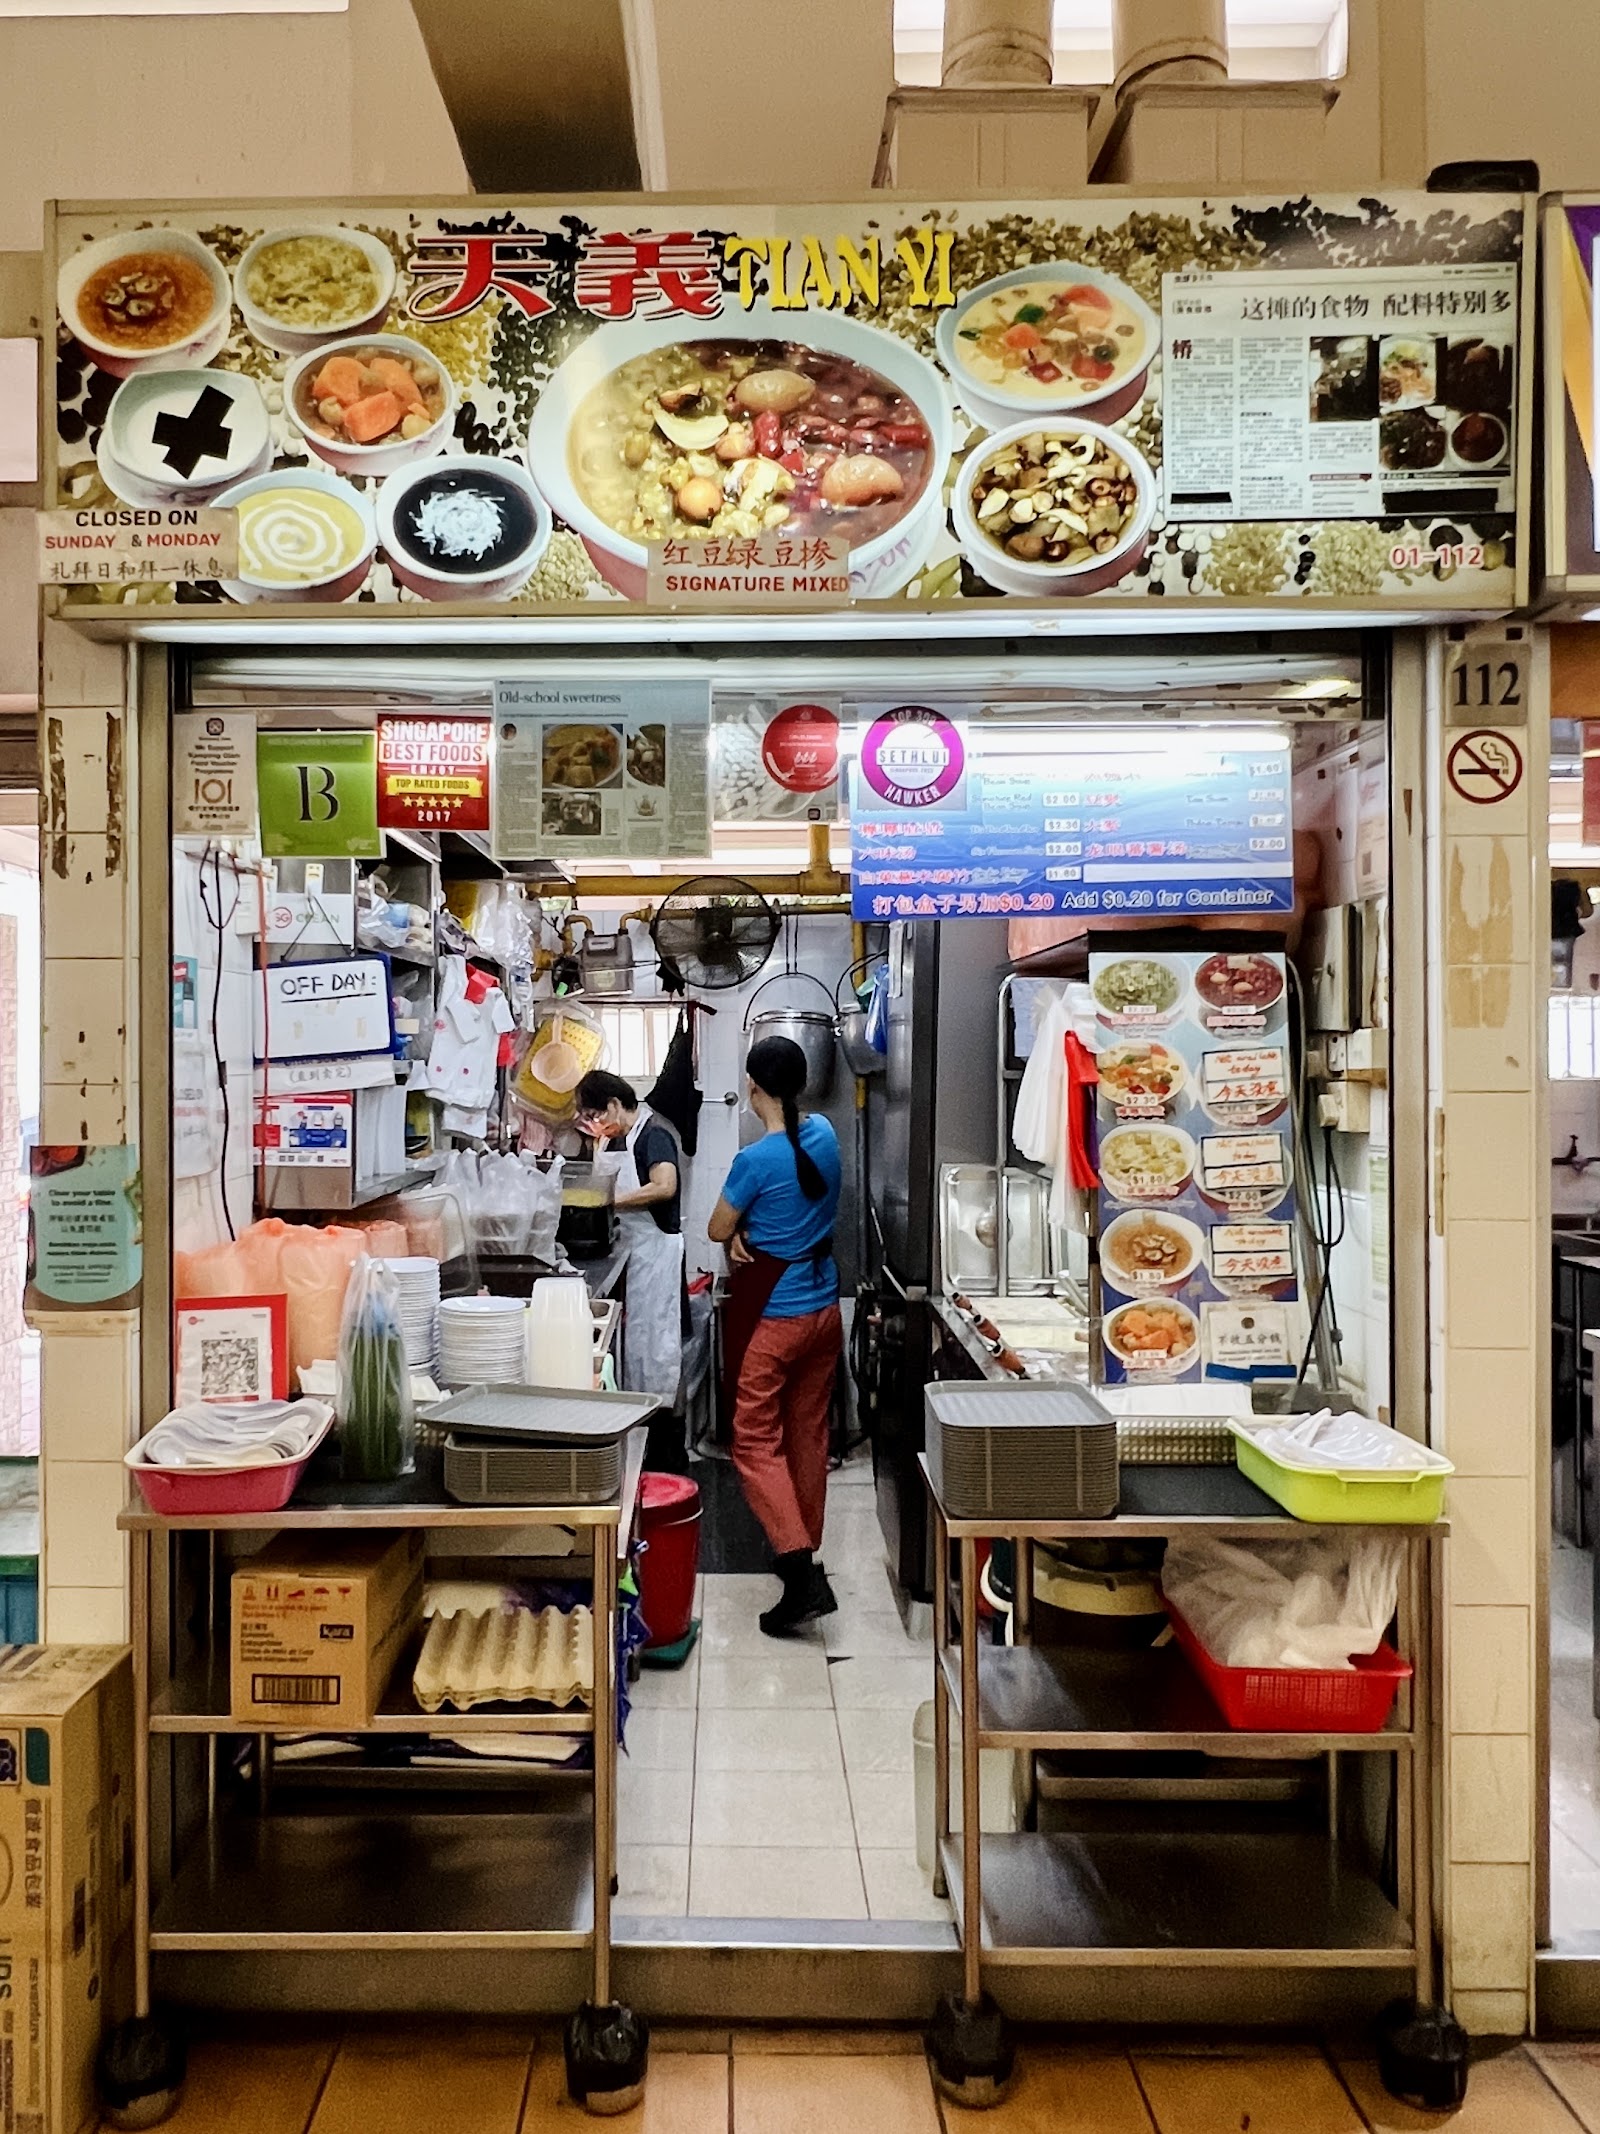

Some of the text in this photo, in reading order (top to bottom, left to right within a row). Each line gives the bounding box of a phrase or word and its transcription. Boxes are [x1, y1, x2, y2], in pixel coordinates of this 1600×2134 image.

[406, 231, 724, 322] 天義
[724, 229, 956, 311] TIAN YI
[1240, 294, 1370, 321] 这摊的食物
[1383, 289, 1512, 318] 配料特别多
[75, 510, 198, 527] CLOSED ON
[45, 533, 222, 549] SUNDAY & MONDAY
[662, 538, 838, 572] 红豆绿豆掺
[1391, 546, 1484, 568] 01-112
[666, 575, 848, 592] SIGNATURE MIXED
[1452, 661, 1521, 706] 112
[499, 690, 622, 704] Old-school sweetness
[380, 720, 487, 742] SINGAPORE
[383, 743, 483, 762] BEST FOODS
[410, 764, 456, 775] ENJOY
[297, 765, 339, 821] B
[396, 779, 470, 790] TOP RATED FOODS
[884, 783, 941, 805] HAWKER
[417, 810, 451, 823] 2017
[1251, 839, 1283, 849] $2.00
[1061, 887, 1275, 909] Add $0.20 for Container
[281, 976, 324, 995] OFF
